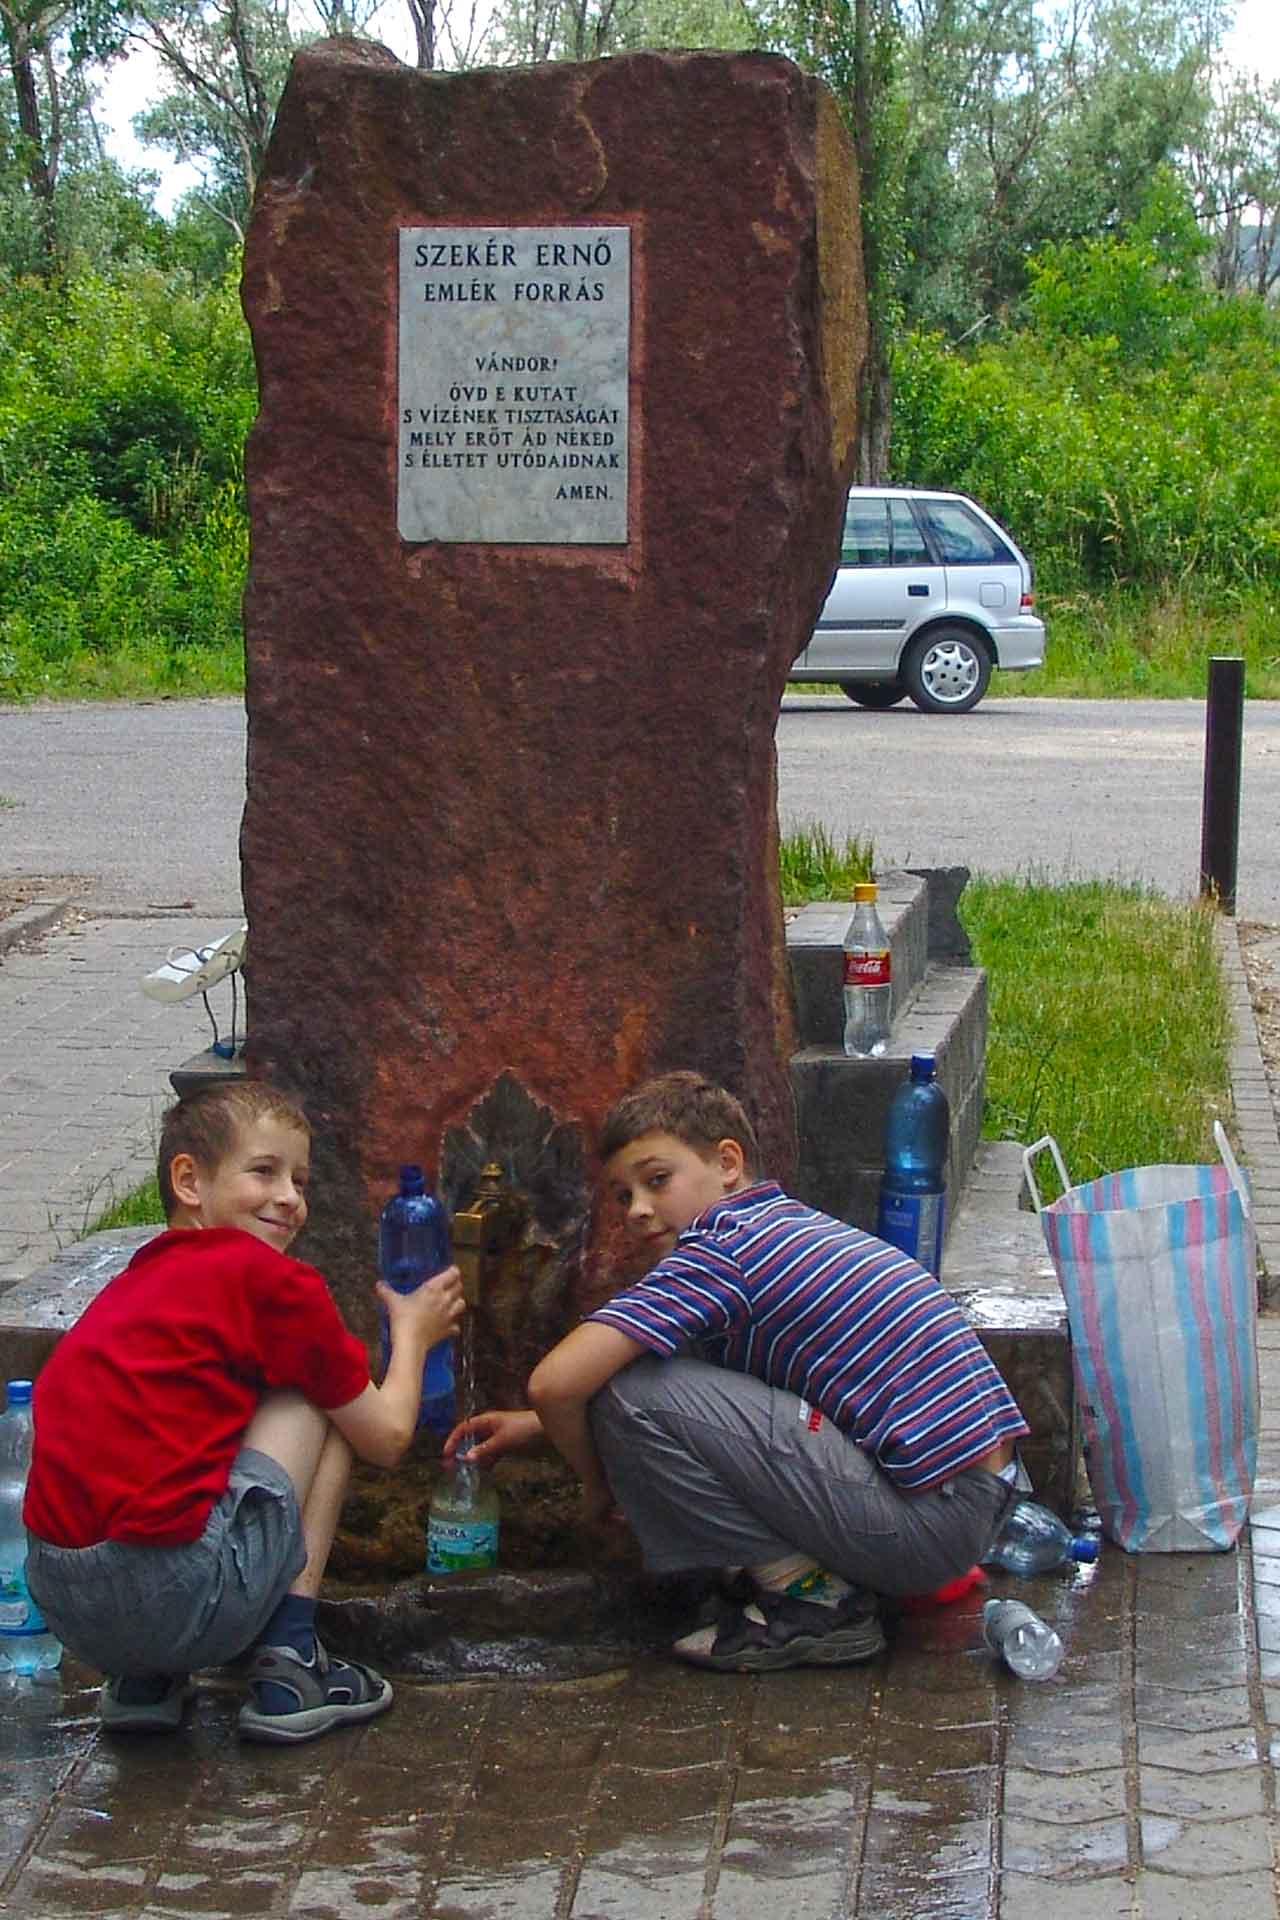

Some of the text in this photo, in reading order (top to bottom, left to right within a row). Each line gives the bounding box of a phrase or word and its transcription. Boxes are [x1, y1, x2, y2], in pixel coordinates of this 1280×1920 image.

[415, 236, 612, 268] SZEKÉR ERNŐ
[424, 276, 605, 302] EMLÉK FORRÁS
[475, 352, 558, 373] VÁNDOR!
[496, 386, 505, 402] E
[513, 386, 577, 402] KUTAT
[403, 403, 620, 424] S VÍZÉNEK TISZTASÁGÁT
[410, 431, 457, 447] MELY
[465, 427, 513, 447] ERŐT
[522, 427, 547, 447] ÁD
[404, 449, 620, 468] S ÉLETET UTÓDAIDNAK
[556, 485, 614, 501] AMEN.
